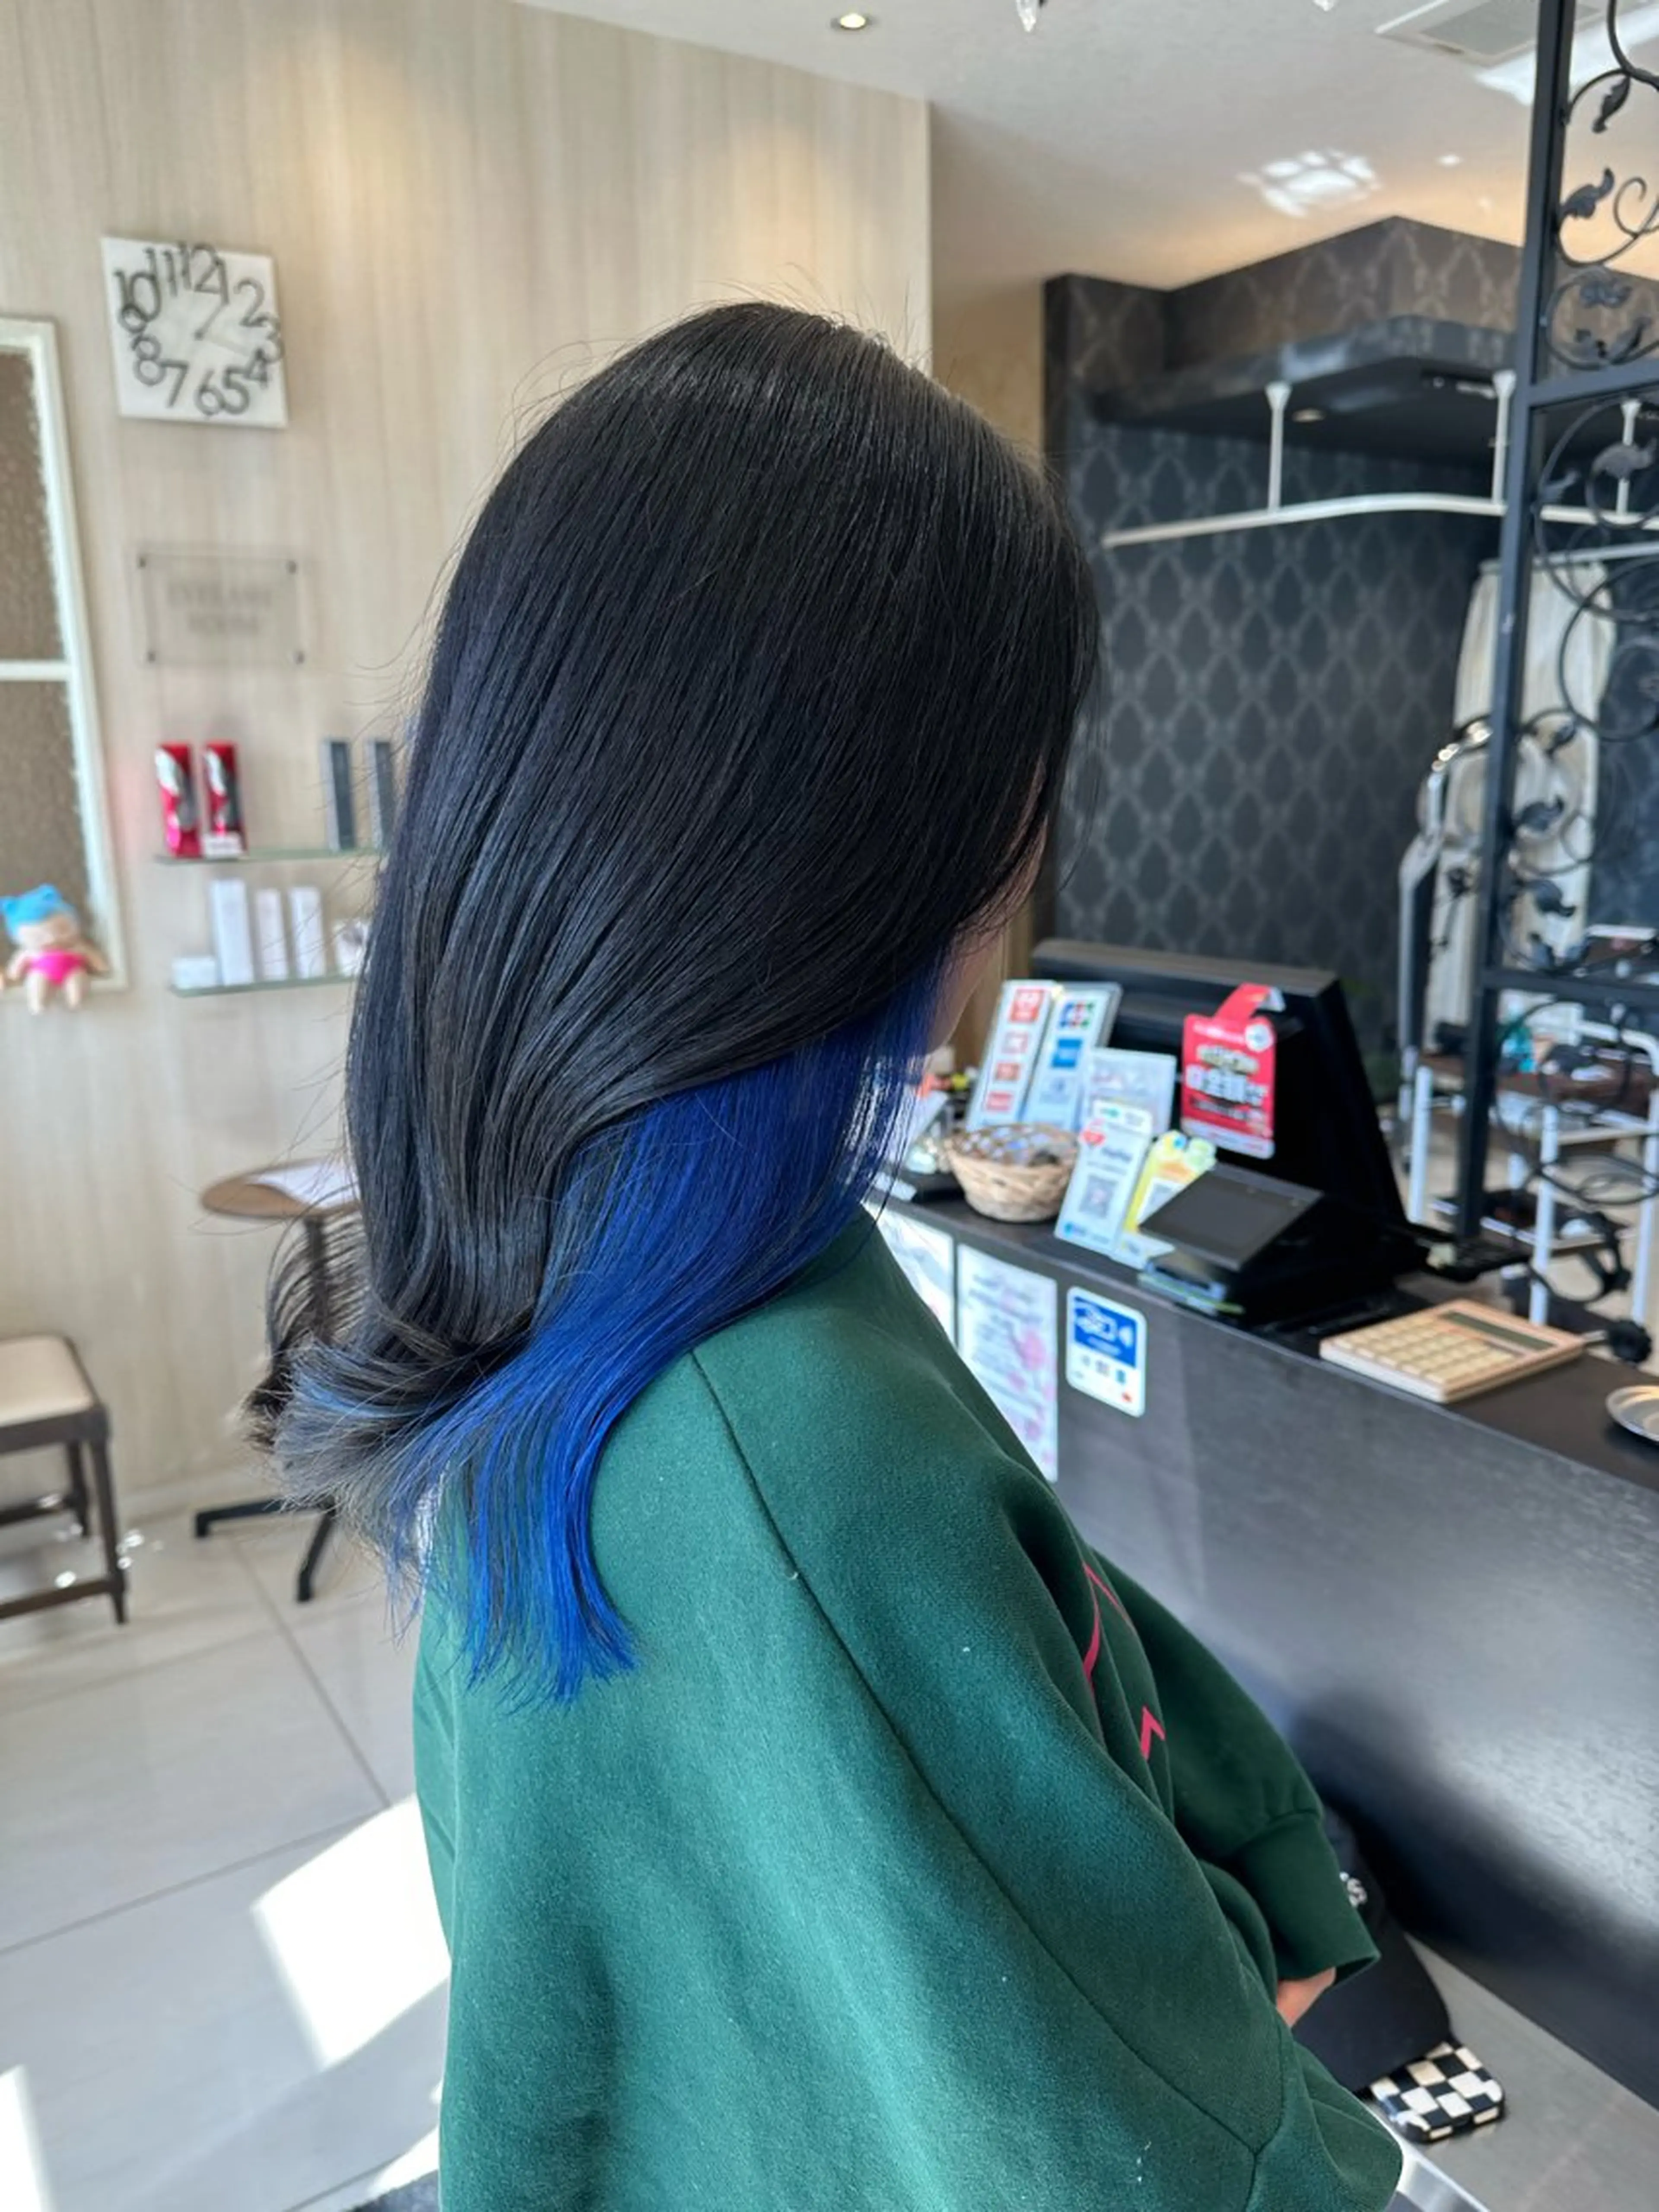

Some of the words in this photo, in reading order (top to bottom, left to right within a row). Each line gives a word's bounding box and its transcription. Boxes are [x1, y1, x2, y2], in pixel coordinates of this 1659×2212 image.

[113, 269, 161, 323] 10
[233, 277, 265, 327] 2
[133, 335, 167, 386] 8
[161, 359, 189, 408] 7
[194, 369, 225, 416] 6
[223, 365, 251, 415] 5
